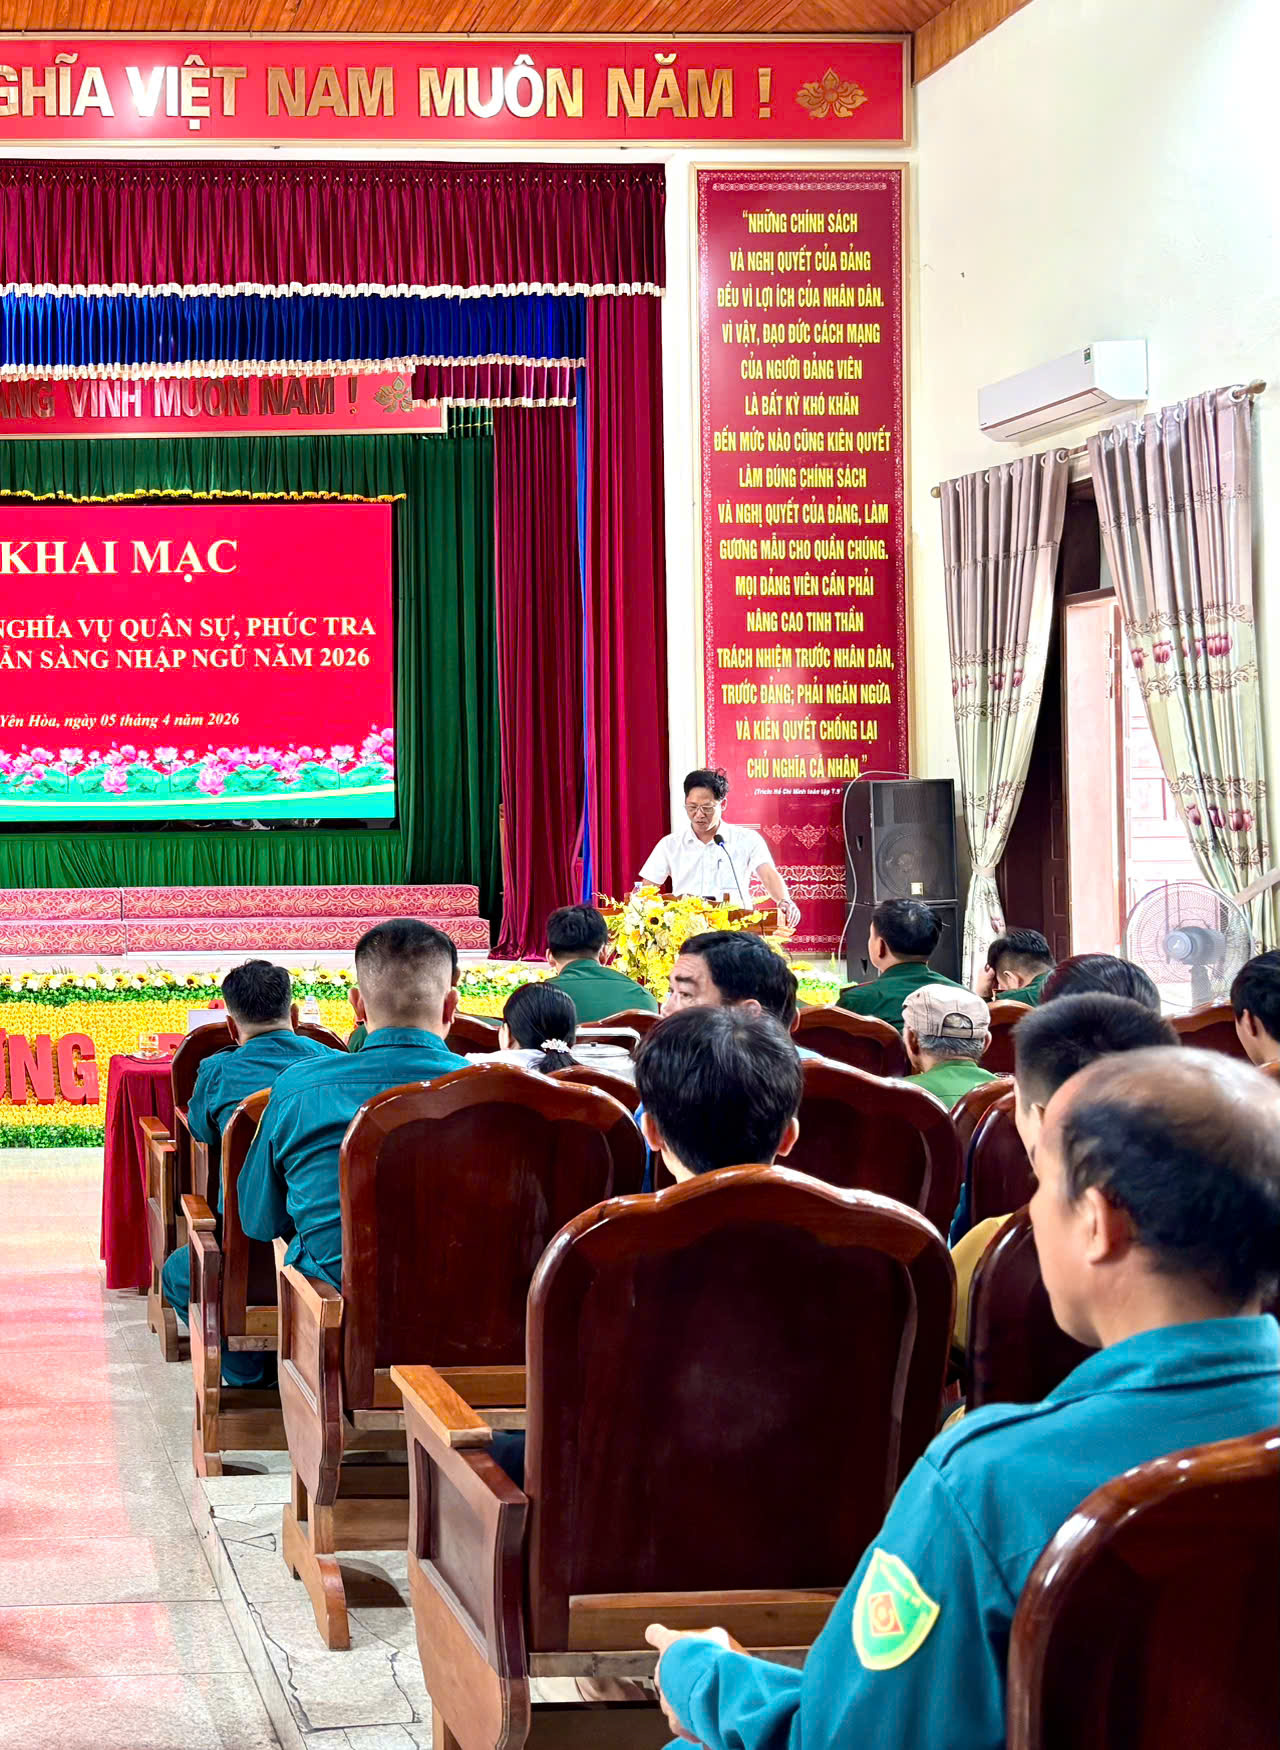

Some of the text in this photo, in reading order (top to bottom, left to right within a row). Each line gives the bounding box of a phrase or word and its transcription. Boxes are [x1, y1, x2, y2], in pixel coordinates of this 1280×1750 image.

[126, 54, 247, 130] VIỆT
[268, 67, 394, 117] NAM
[419, 54, 583, 118] MUÔN
[607, 53, 733, 118] NĂM
[758, 67, 771, 118] !
[790, 209, 824, 233] CHÍNH
[827, 209, 858, 233] SÁCH
[730, 243, 871, 275] VÀ NGHỊ QUYẾT CỦA ĐẢNG
[717, 281, 739, 307] ĐỀU
[742, 283, 752, 307] VÌ
[756, 286, 773, 312] LỢI
[776, 283, 795, 307] ÍCH
[798, 279, 820, 307] CỦA
[823, 283, 856, 307] NHÂN
[741, 352, 862, 379] CỦA NGƯỜI ĐẢNG VIÊN
[714, 425, 893, 454] ĐẾN MỨC NÀO CŨNG KIÊN QUYẾT
[739, 464, 866, 489] LÀM ĐÚNG CHÍNH SÁCH
[131, 539, 238, 583] MẠC
[717, 538, 758, 560] GƯƠNG
[760, 532, 786, 560] MẪU
[787, 539, 811, 560] CHO
[814, 533, 845, 562] QUẦN
[77, 619, 113, 643] VỤ
[119, 612, 193, 642] QUÂN
[199, 614, 241, 642] SỰ,
[247, 612, 317, 637] PHÚC
[323, 616, 377, 636] TRA
[747, 605, 864, 632] NÂNG CAO TINH THẦN
[40, 644, 109, 670] SÀNG
[115, 645, 187, 673] NHẬP
[191, 643, 247, 668] NGŨ
[253, 643, 313, 667] NĂM
[319, 647, 370, 667] 2026
[719, 675, 757, 705] TRƯỚC
[797, 676, 823, 704] PHẢI
[826, 680, 857, 704] NGĂN
[860, 679, 891, 704] NGỪA
[0, 712, 240, 730] Yên Hòa, ngày 05 tháng 4 năm 2026
